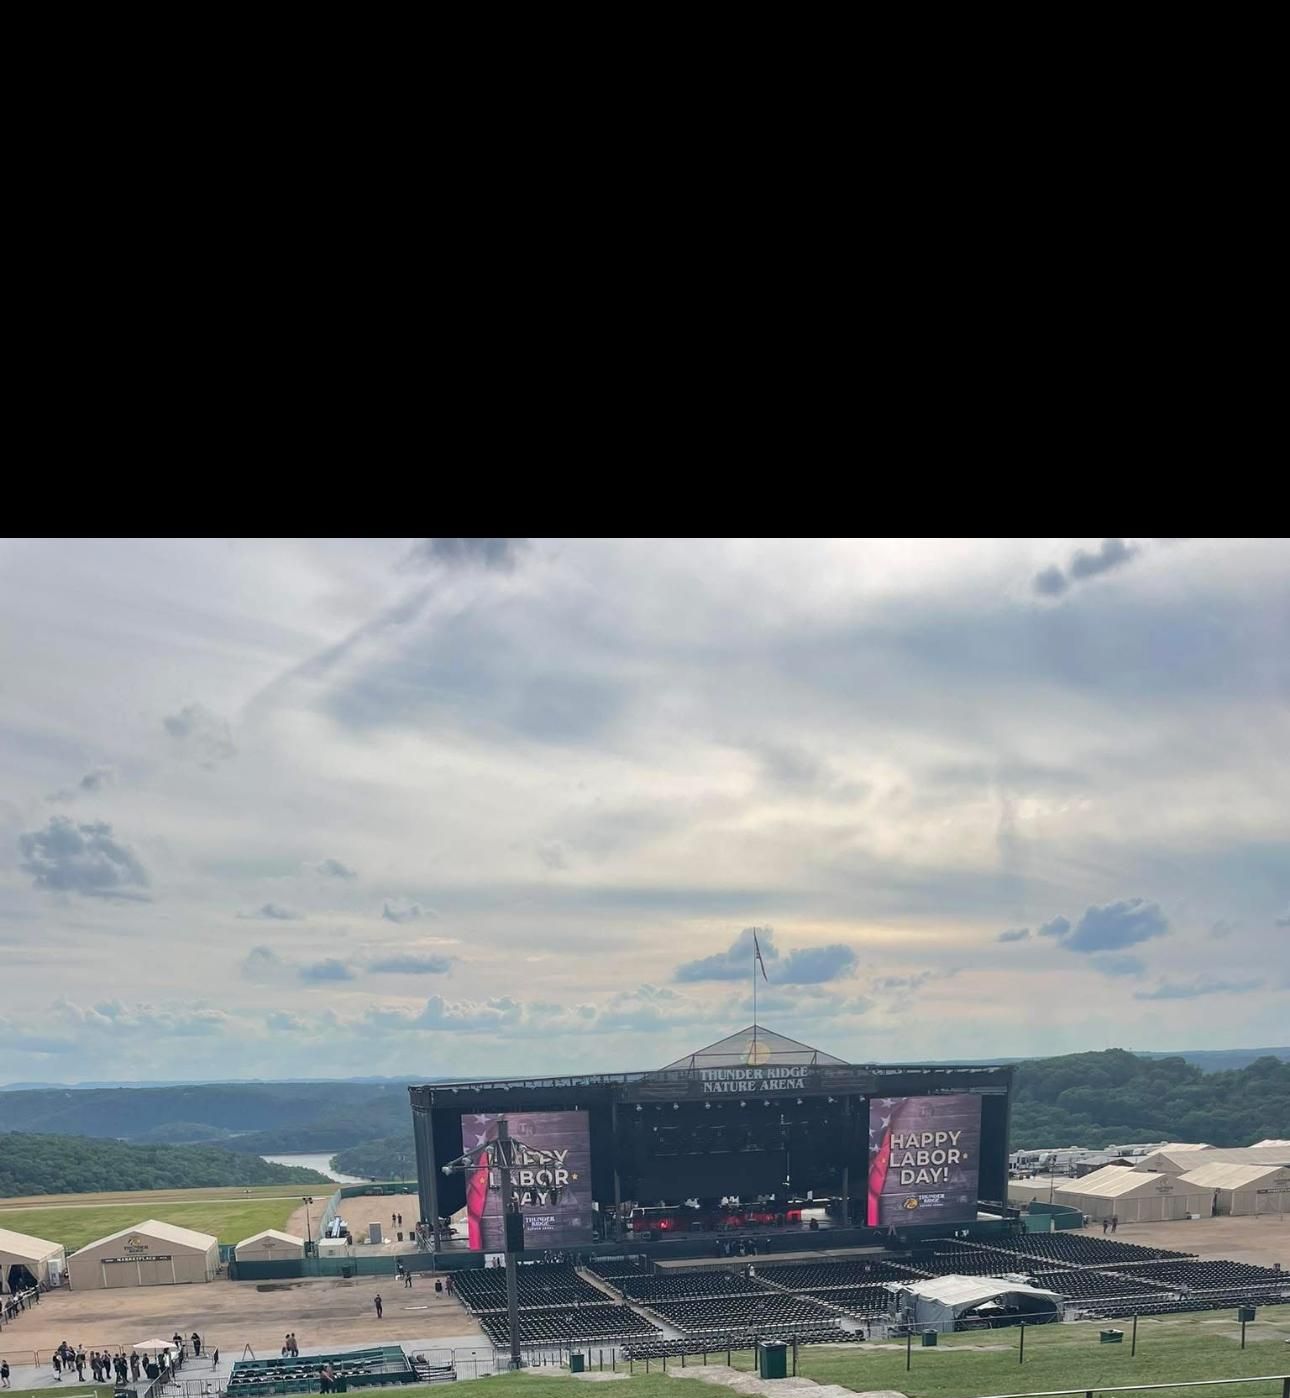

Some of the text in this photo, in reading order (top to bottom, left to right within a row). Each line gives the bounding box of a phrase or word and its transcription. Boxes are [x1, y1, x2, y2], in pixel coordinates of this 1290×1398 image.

[701, 1066, 809, 1081] THUNDER RIDGE
[703, 1079, 805, 1093] NATURE ARENA
[890, 1130, 962, 1150] HAPPY
[889, 1148, 961, 1168] LABOR
[900, 1167, 949, 1185] DAY!
